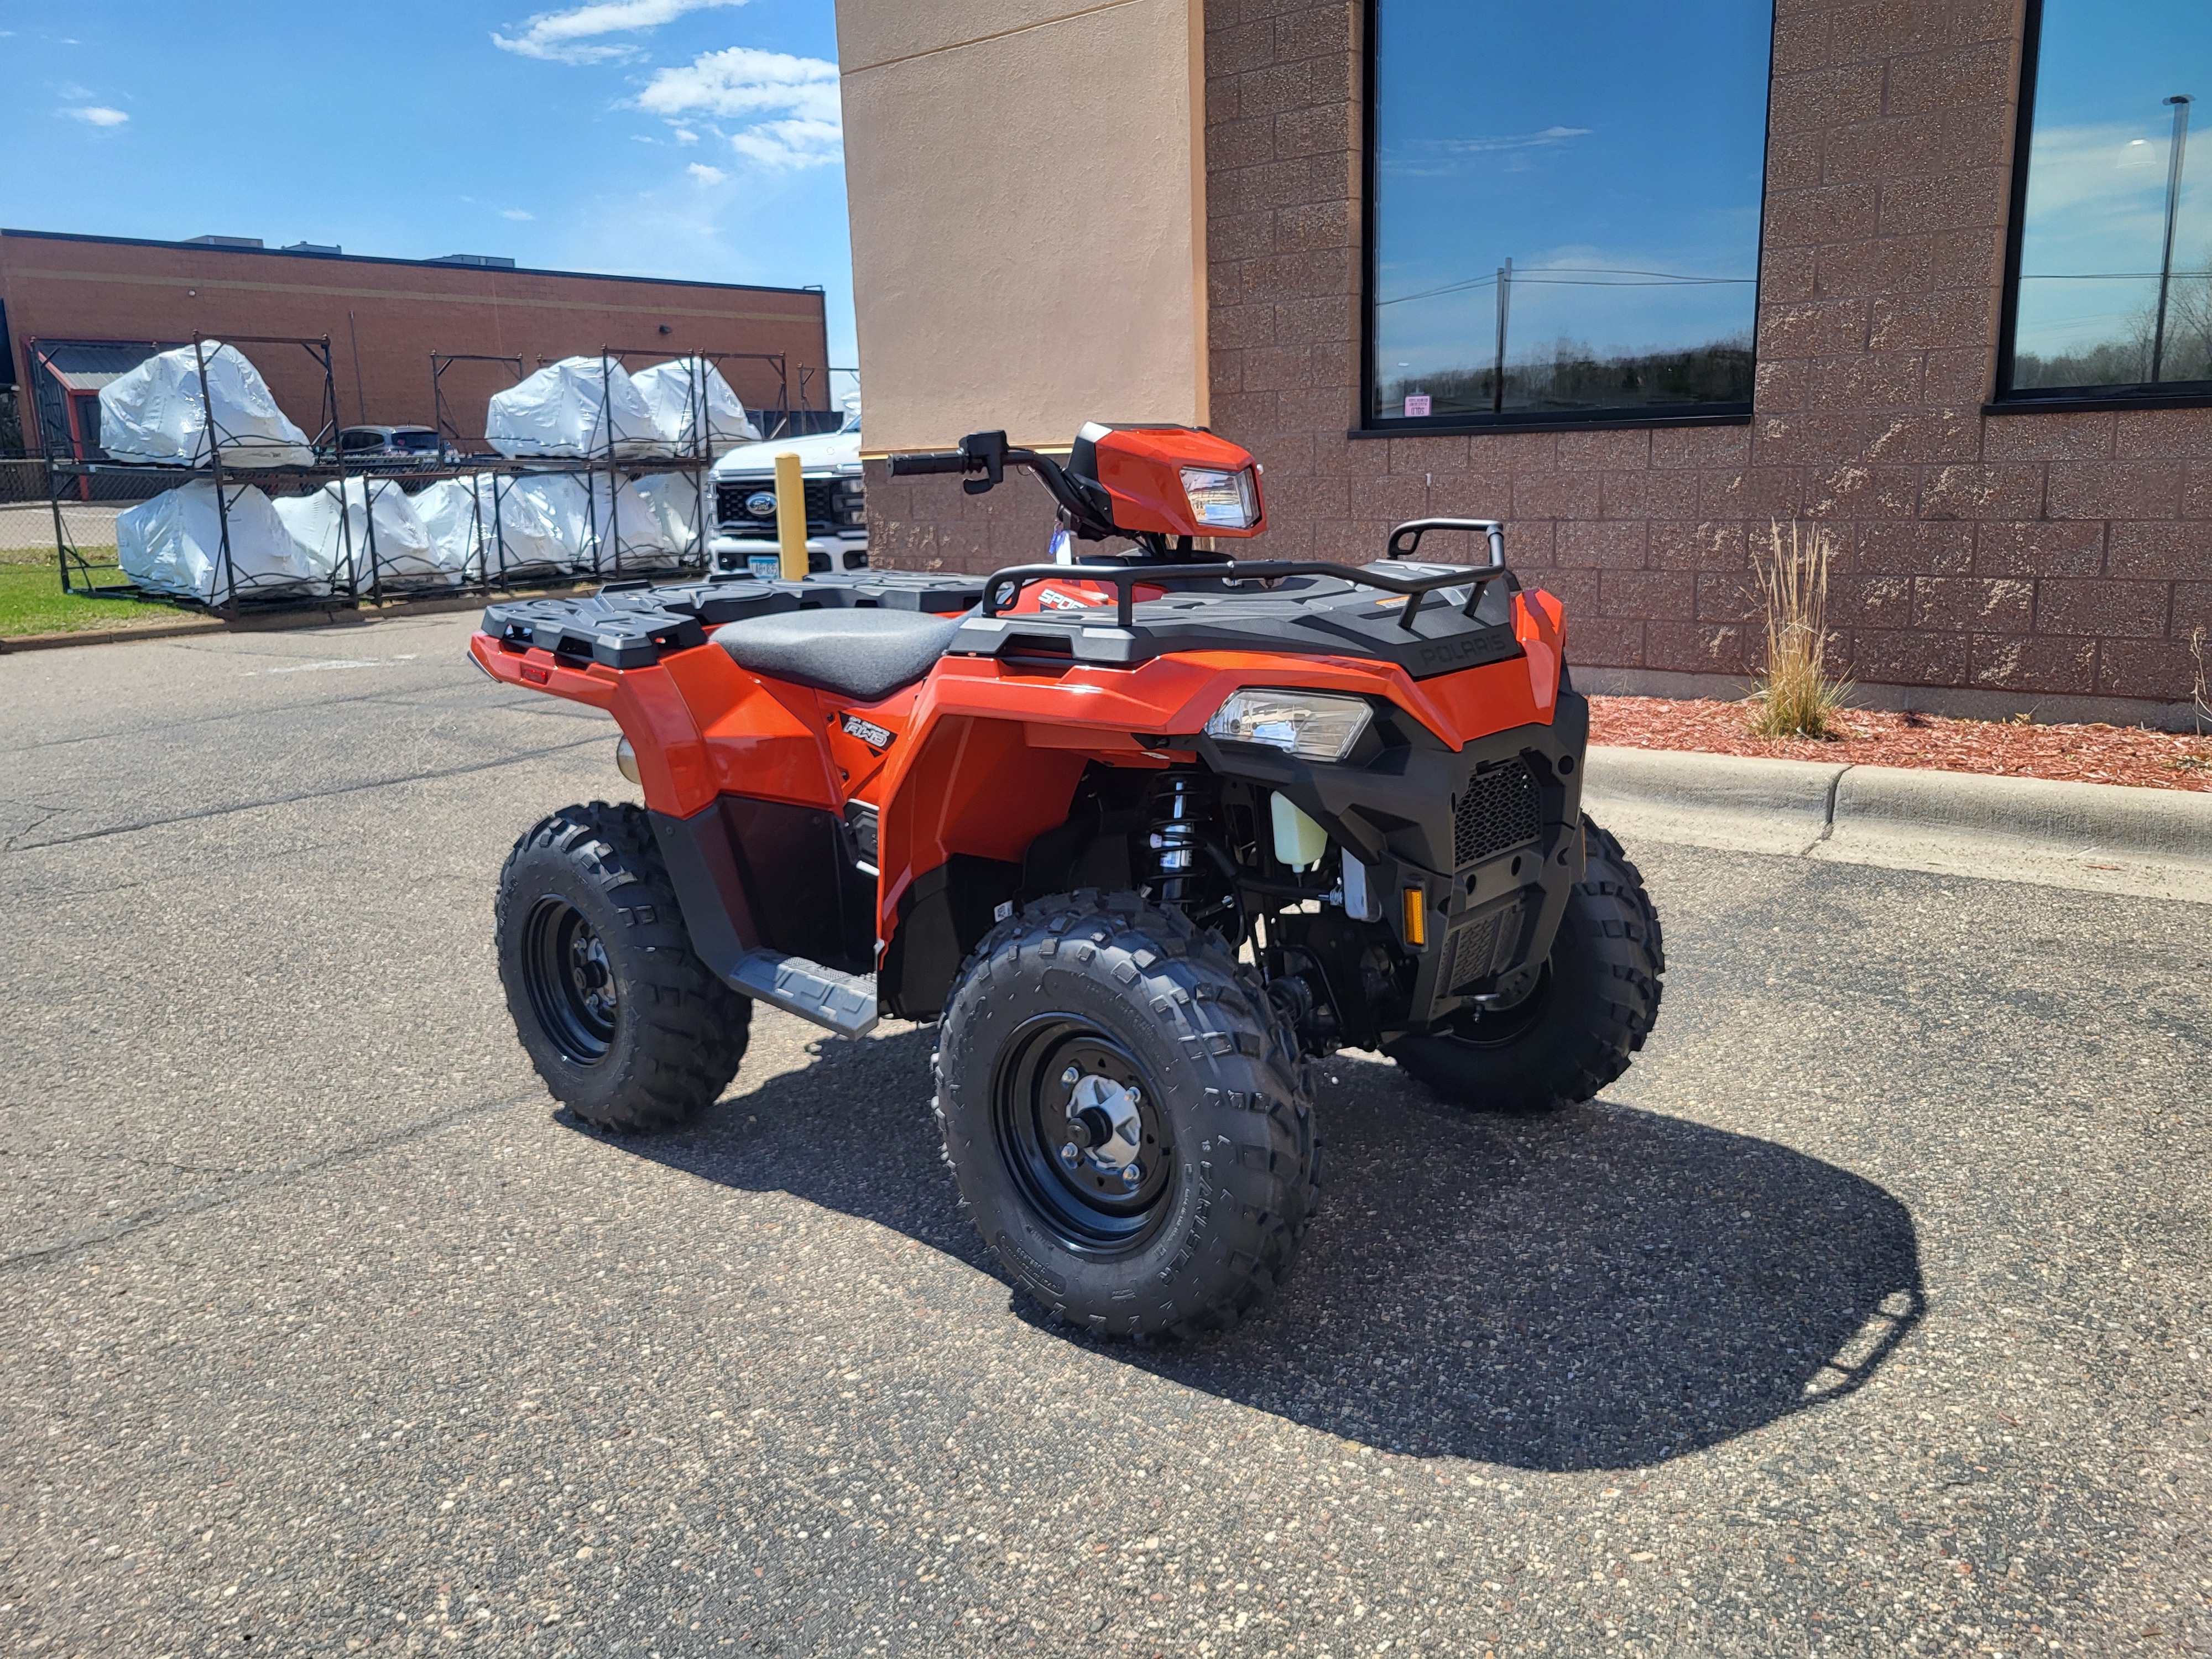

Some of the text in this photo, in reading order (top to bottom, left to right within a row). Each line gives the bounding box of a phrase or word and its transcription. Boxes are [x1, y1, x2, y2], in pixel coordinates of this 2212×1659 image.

[1038, 588, 1089, 609] SPOR
[1419, 635, 1505, 666] POLARIS
[843, 721, 887, 747] AWD
